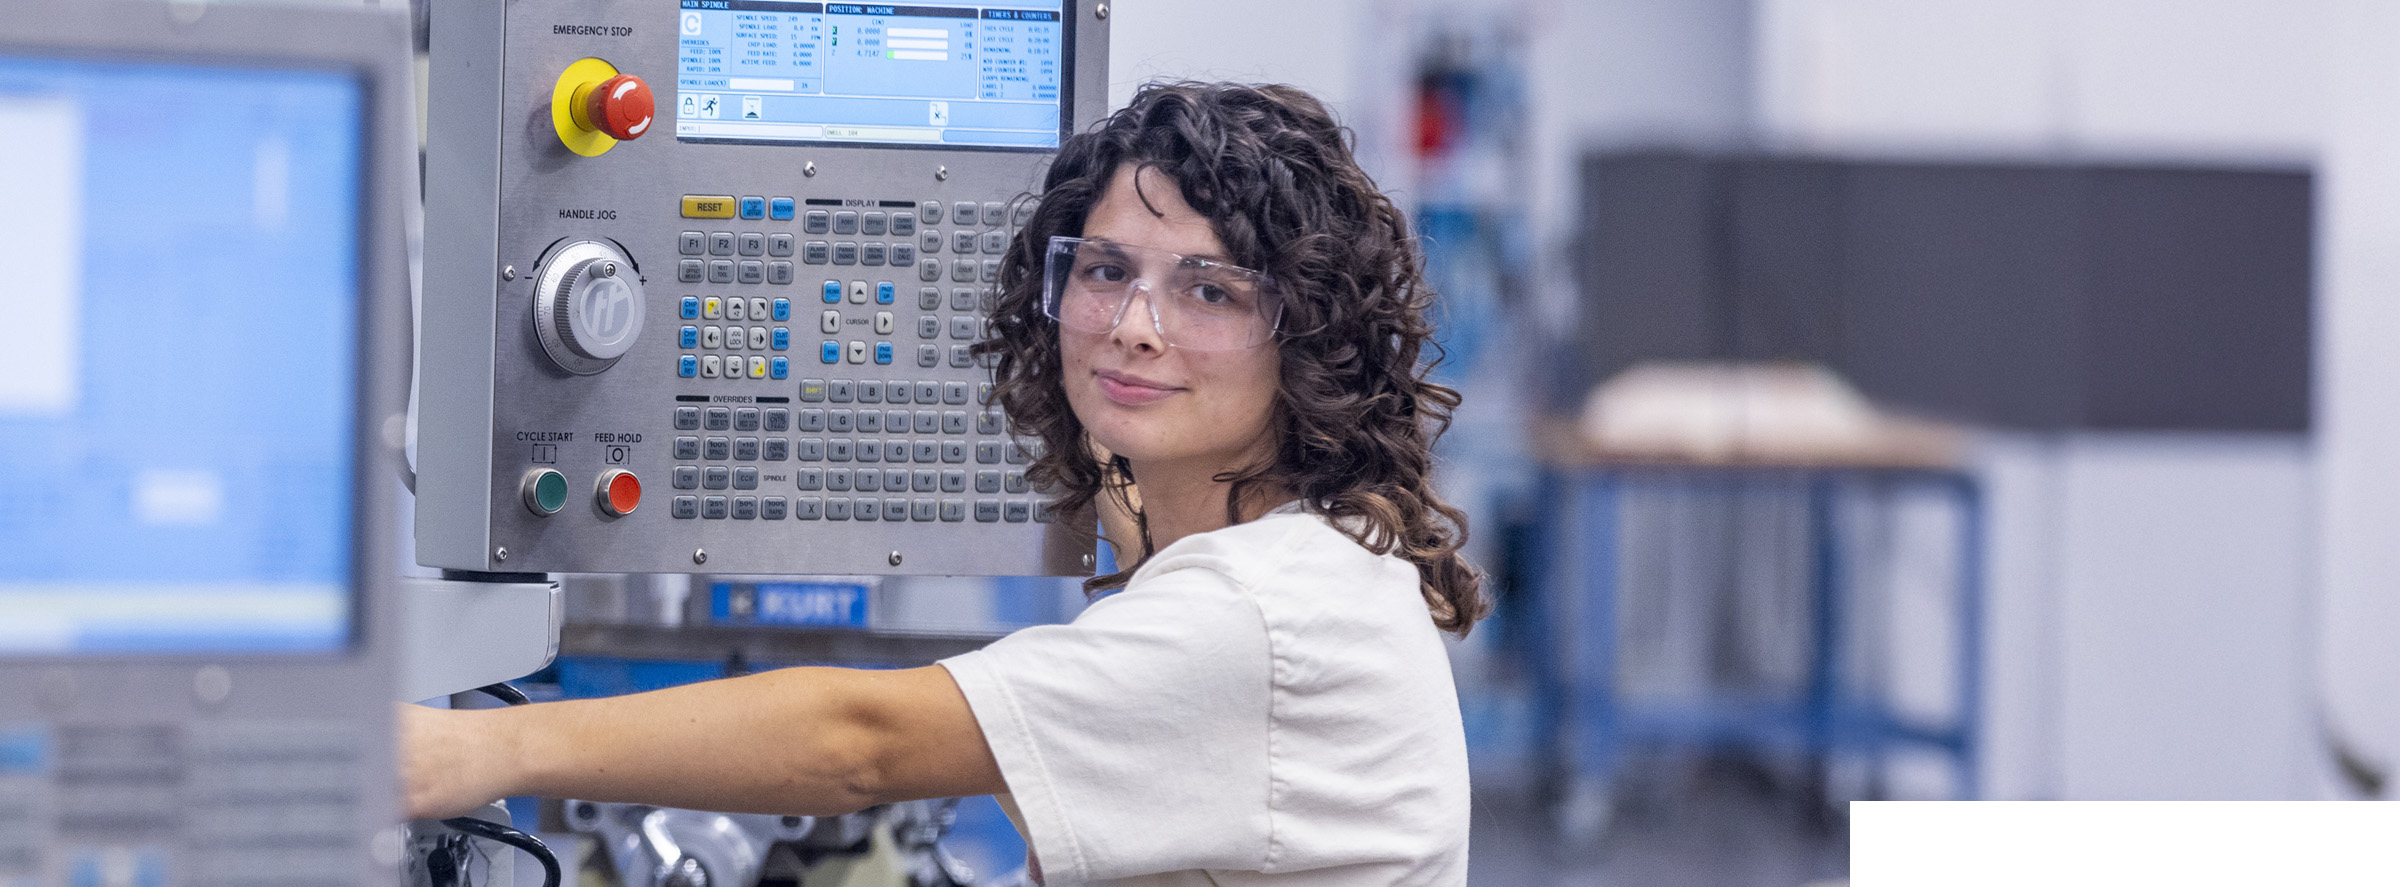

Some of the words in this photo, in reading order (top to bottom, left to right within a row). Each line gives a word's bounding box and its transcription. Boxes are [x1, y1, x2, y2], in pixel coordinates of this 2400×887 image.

[681, 0, 699, 8] MAIN
[701, 0, 729, 9] SPINDLE
[828, 5, 863, 14] POSITION:
[866, 6, 895, 15] MACHINE
[553, 24, 609, 36] EMERGENCY
[611, 27, 633, 37] STOP
[697, 202, 723, 212] RESET
[845, 199, 876, 208] DISPLAY
[559, 209, 595, 220] HANDLE
[596, 210, 617, 220] JOG
[689, 239, 699, 248] F1
[718, 239, 729, 249] F2
[748, 240, 759, 249] F3
[777, 240, 788, 250] F4
[840, 386, 846, 395] A
[869, 387, 875, 396] B
[898, 387, 904, 397] C
[926, 388, 933, 397] D
[955, 388, 960, 397] E
[713, 395, 753, 404] OVERRIDES
[811, 416, 816, 425] F
[839, 416, 846, 425] G
[868, 416, 875, 425] H
[926, 417, 931, 426] J
[954, 418, 960, 426] K
[516, 431, 546, 441] CYCLE
[548, 432, 574, 441] START
[595, 433, 615, 443] FEED
[618, 433, 642, 443] HOLD
[810, 445, 815, 454] L
[838, 446, 845, 454] M
[867, 445, 874, 454] N
[896, 446, 903, 456] O
[925, 446, 931, 455] P
[953, 447, 960, 456] Q
[809, 475, 815, 484] R
[838, 475, 844, 484] S
[867, 475, 872, 484] T
[896, 476, 902, 485] U
[924, 476, 930, 485] V
[951, 477, 959, 485] W
[808, 504, 814, 513] X
[837, 504, 843, 513] Y
[866, 504, 872, 513] Z
